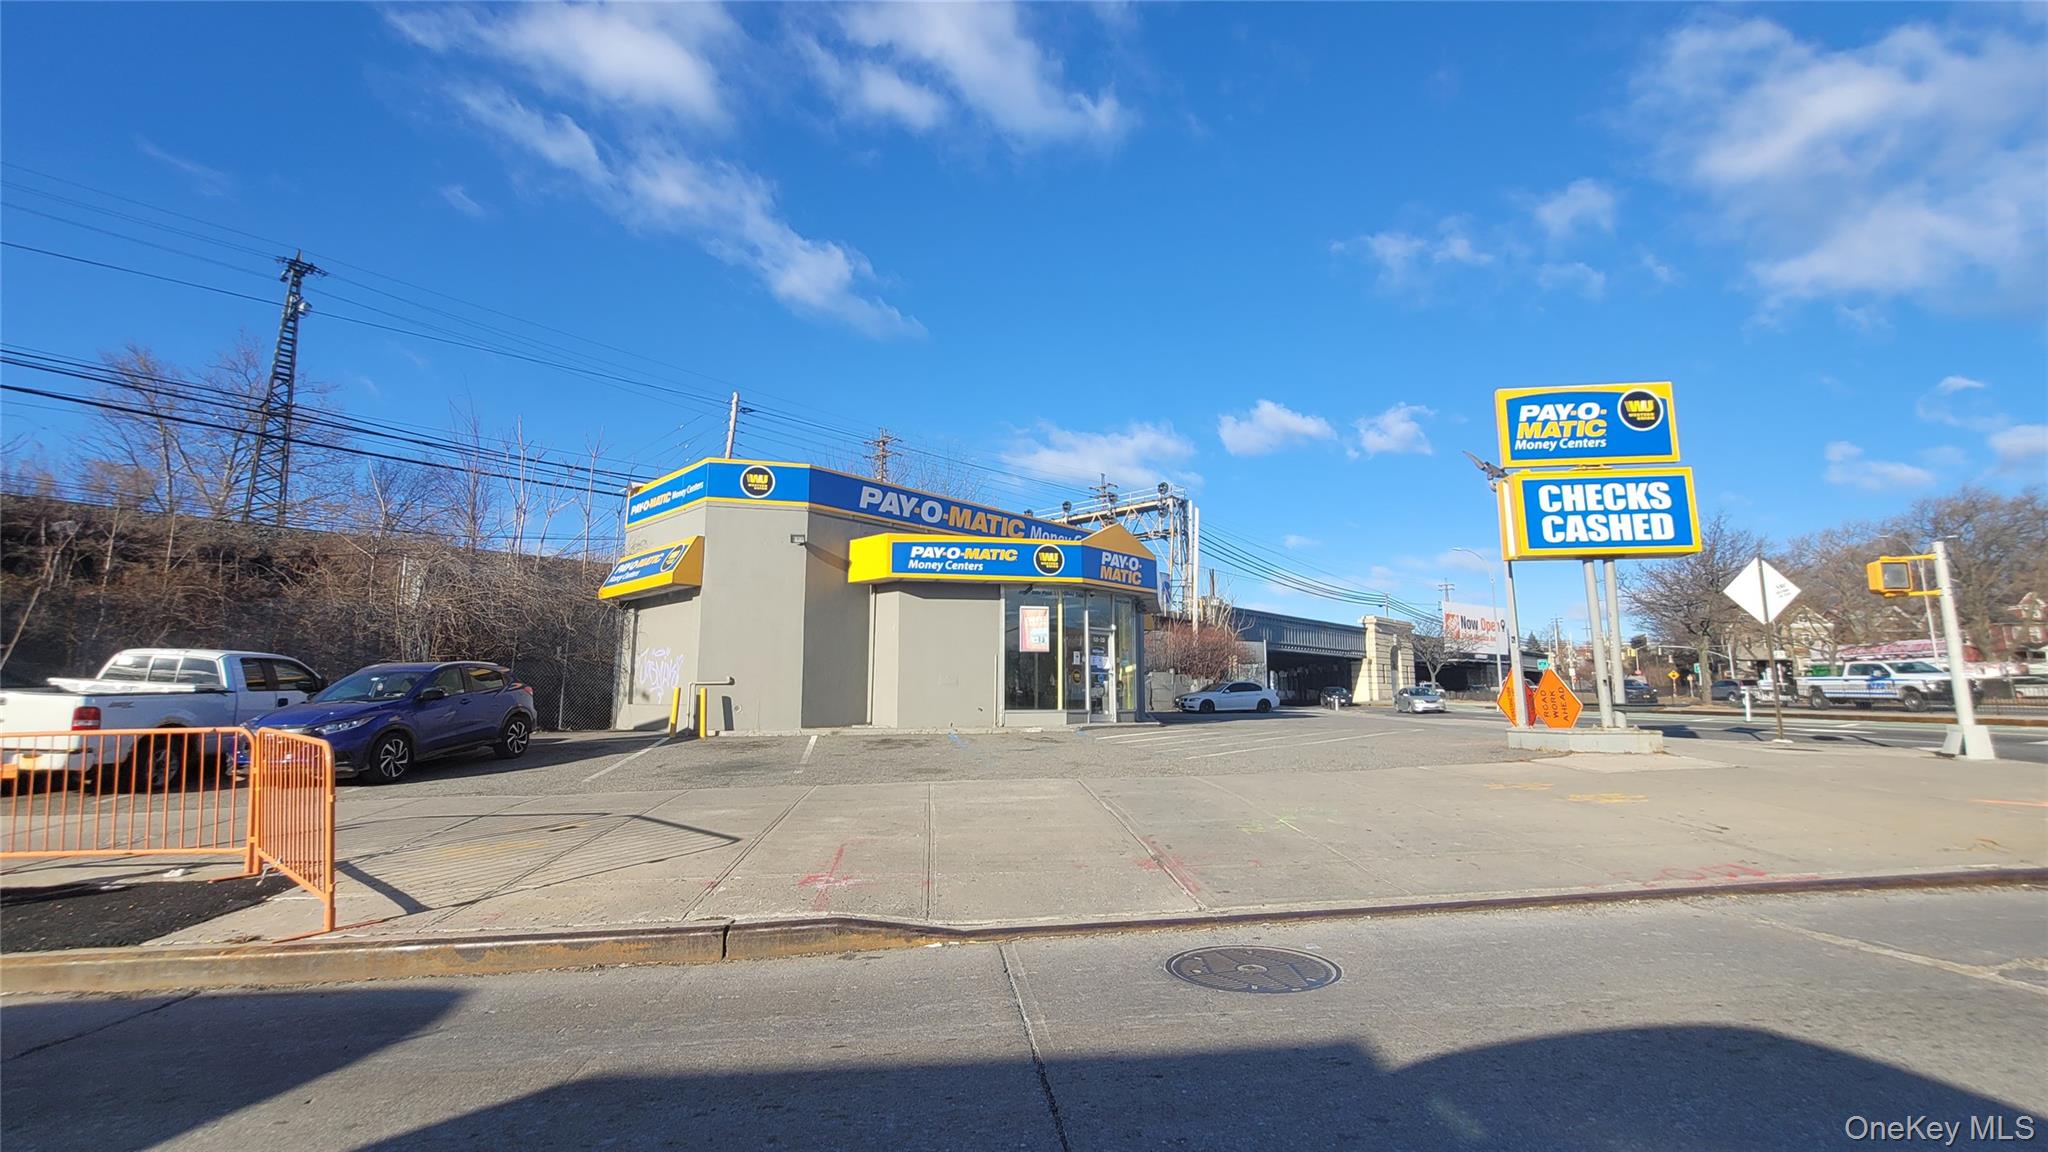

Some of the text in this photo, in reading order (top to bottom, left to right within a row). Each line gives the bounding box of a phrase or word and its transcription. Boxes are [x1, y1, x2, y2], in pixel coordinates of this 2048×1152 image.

[1516, 419, 1608, 440] MATIC
[1514, 437, 1607, 451] Money Centers
[1538, 481, 1673, 513] CHECKS
[859, 485, 1025, 539] PAY-O-MATIC
[1541, 512, 1675, 544] CASHED
[907, 560, 984, 572] Money Centers
[910, 546, 1018, 562] PAY-O-MATIC
[1100, 565, 1142, 585] MATIC
[1460, 615, 1479, 630] Now
[1541, 690, 1549, 718] ROAD
[1550, 690, 1559, 719] WORK
[1558, 686, 1569, 722] AHEAD
